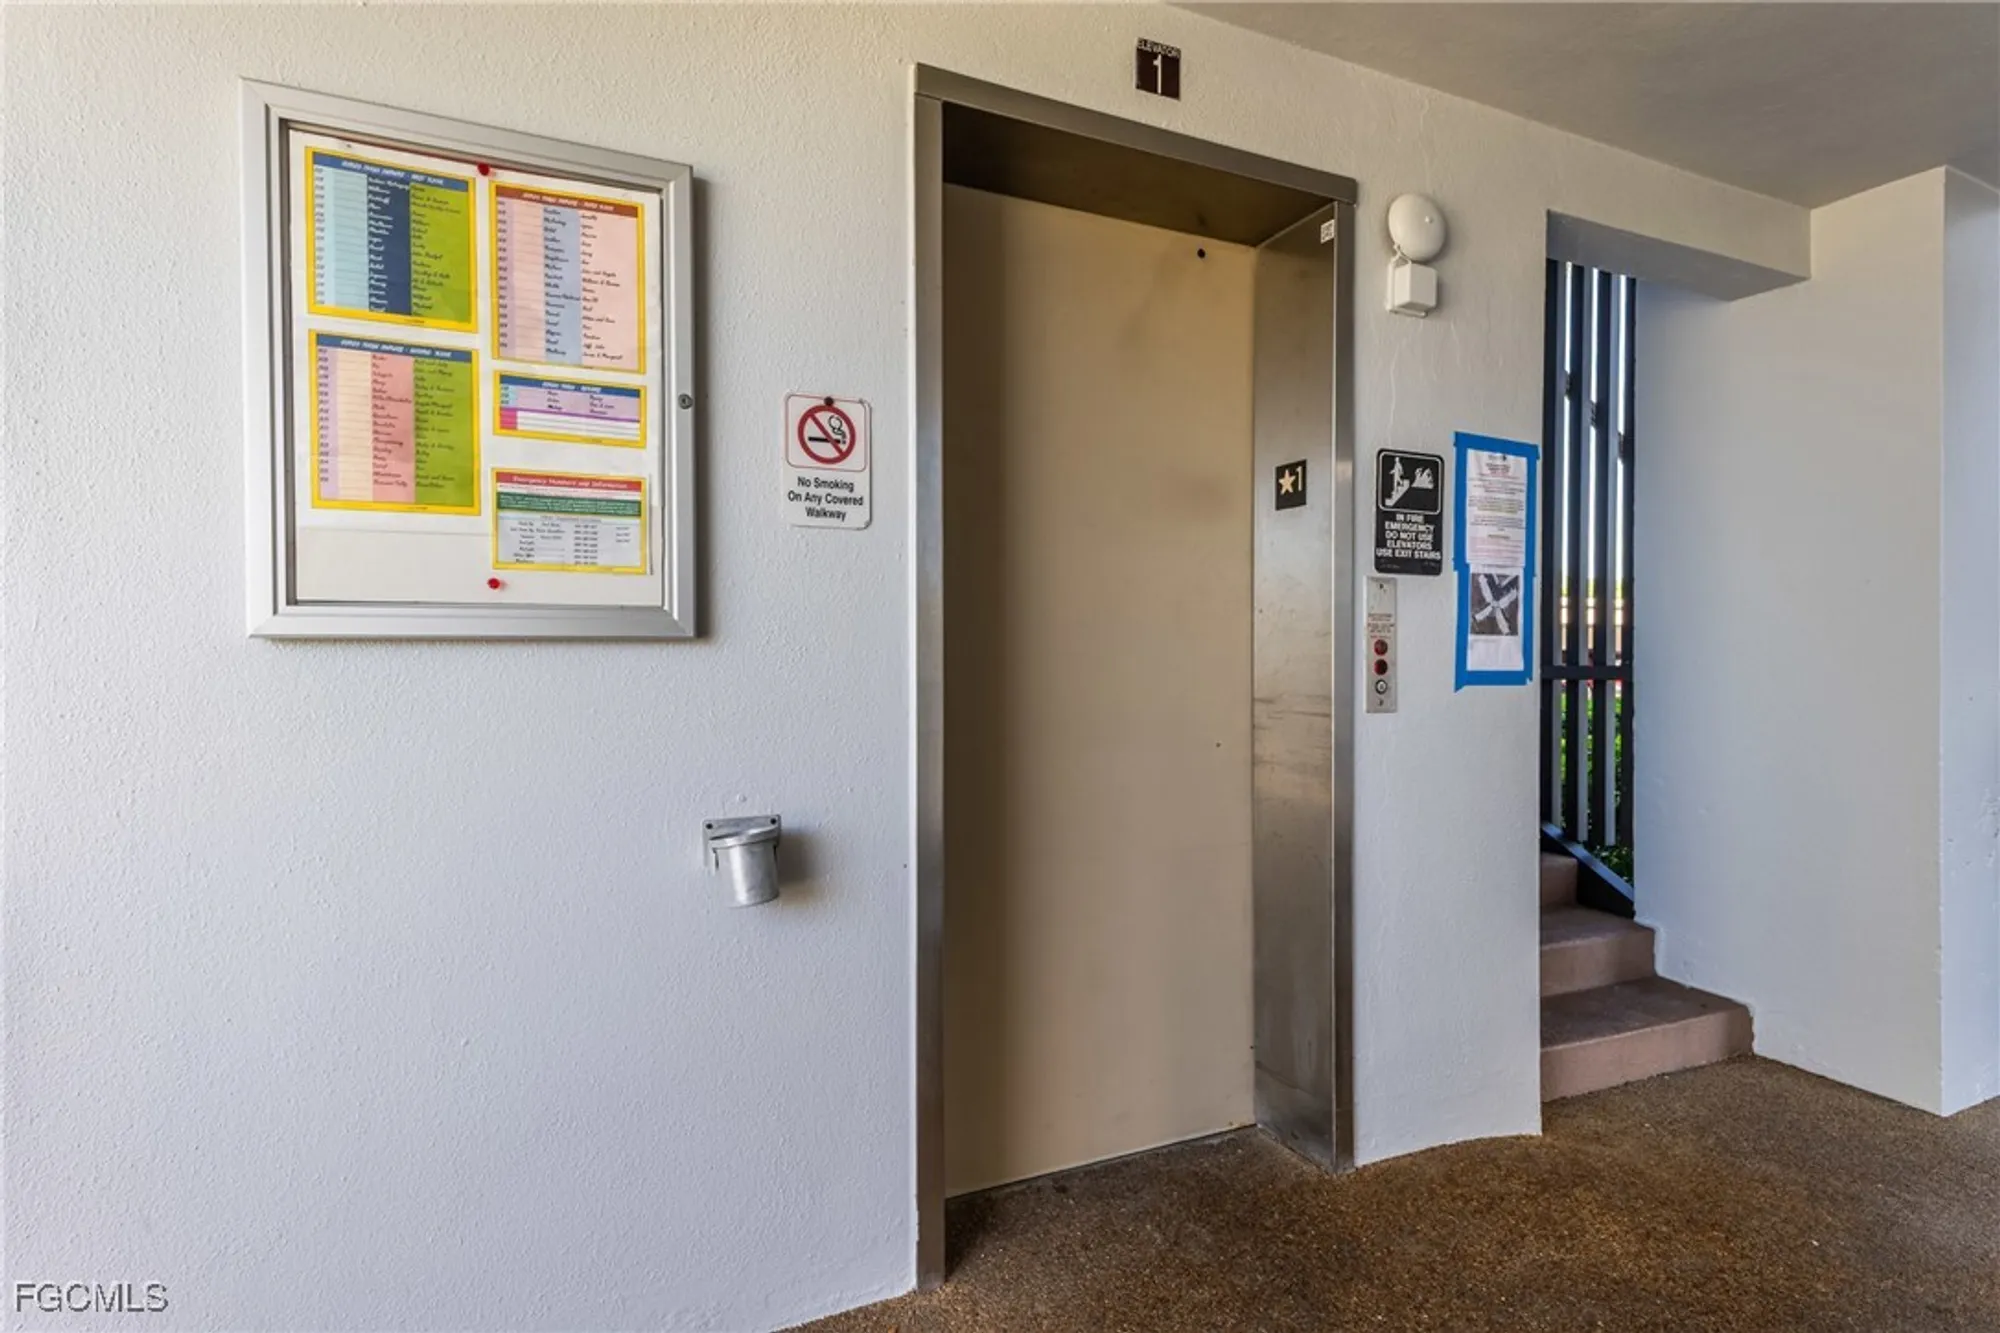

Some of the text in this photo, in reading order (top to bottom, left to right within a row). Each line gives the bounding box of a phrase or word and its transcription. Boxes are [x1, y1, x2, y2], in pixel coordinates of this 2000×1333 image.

[1152, 54, 1162, 95] 1
[797, 476, 854, 493] No Smoking
[1296, 466, 1303, 491] 1
[788, 490, 864, 506] On Any Covered
[805, 506, 847, 522] Walkway
[1407, 514, 1424, 524] FIRE
[1385, 521, 1435, 533] EMERGENCY
[1385, 530, 1433, 542] DO NOT USE
[1386, 539, 1432, 550] ELEVATORS
[1376, 548, 1441, 560] USE EXIT STAIRS
